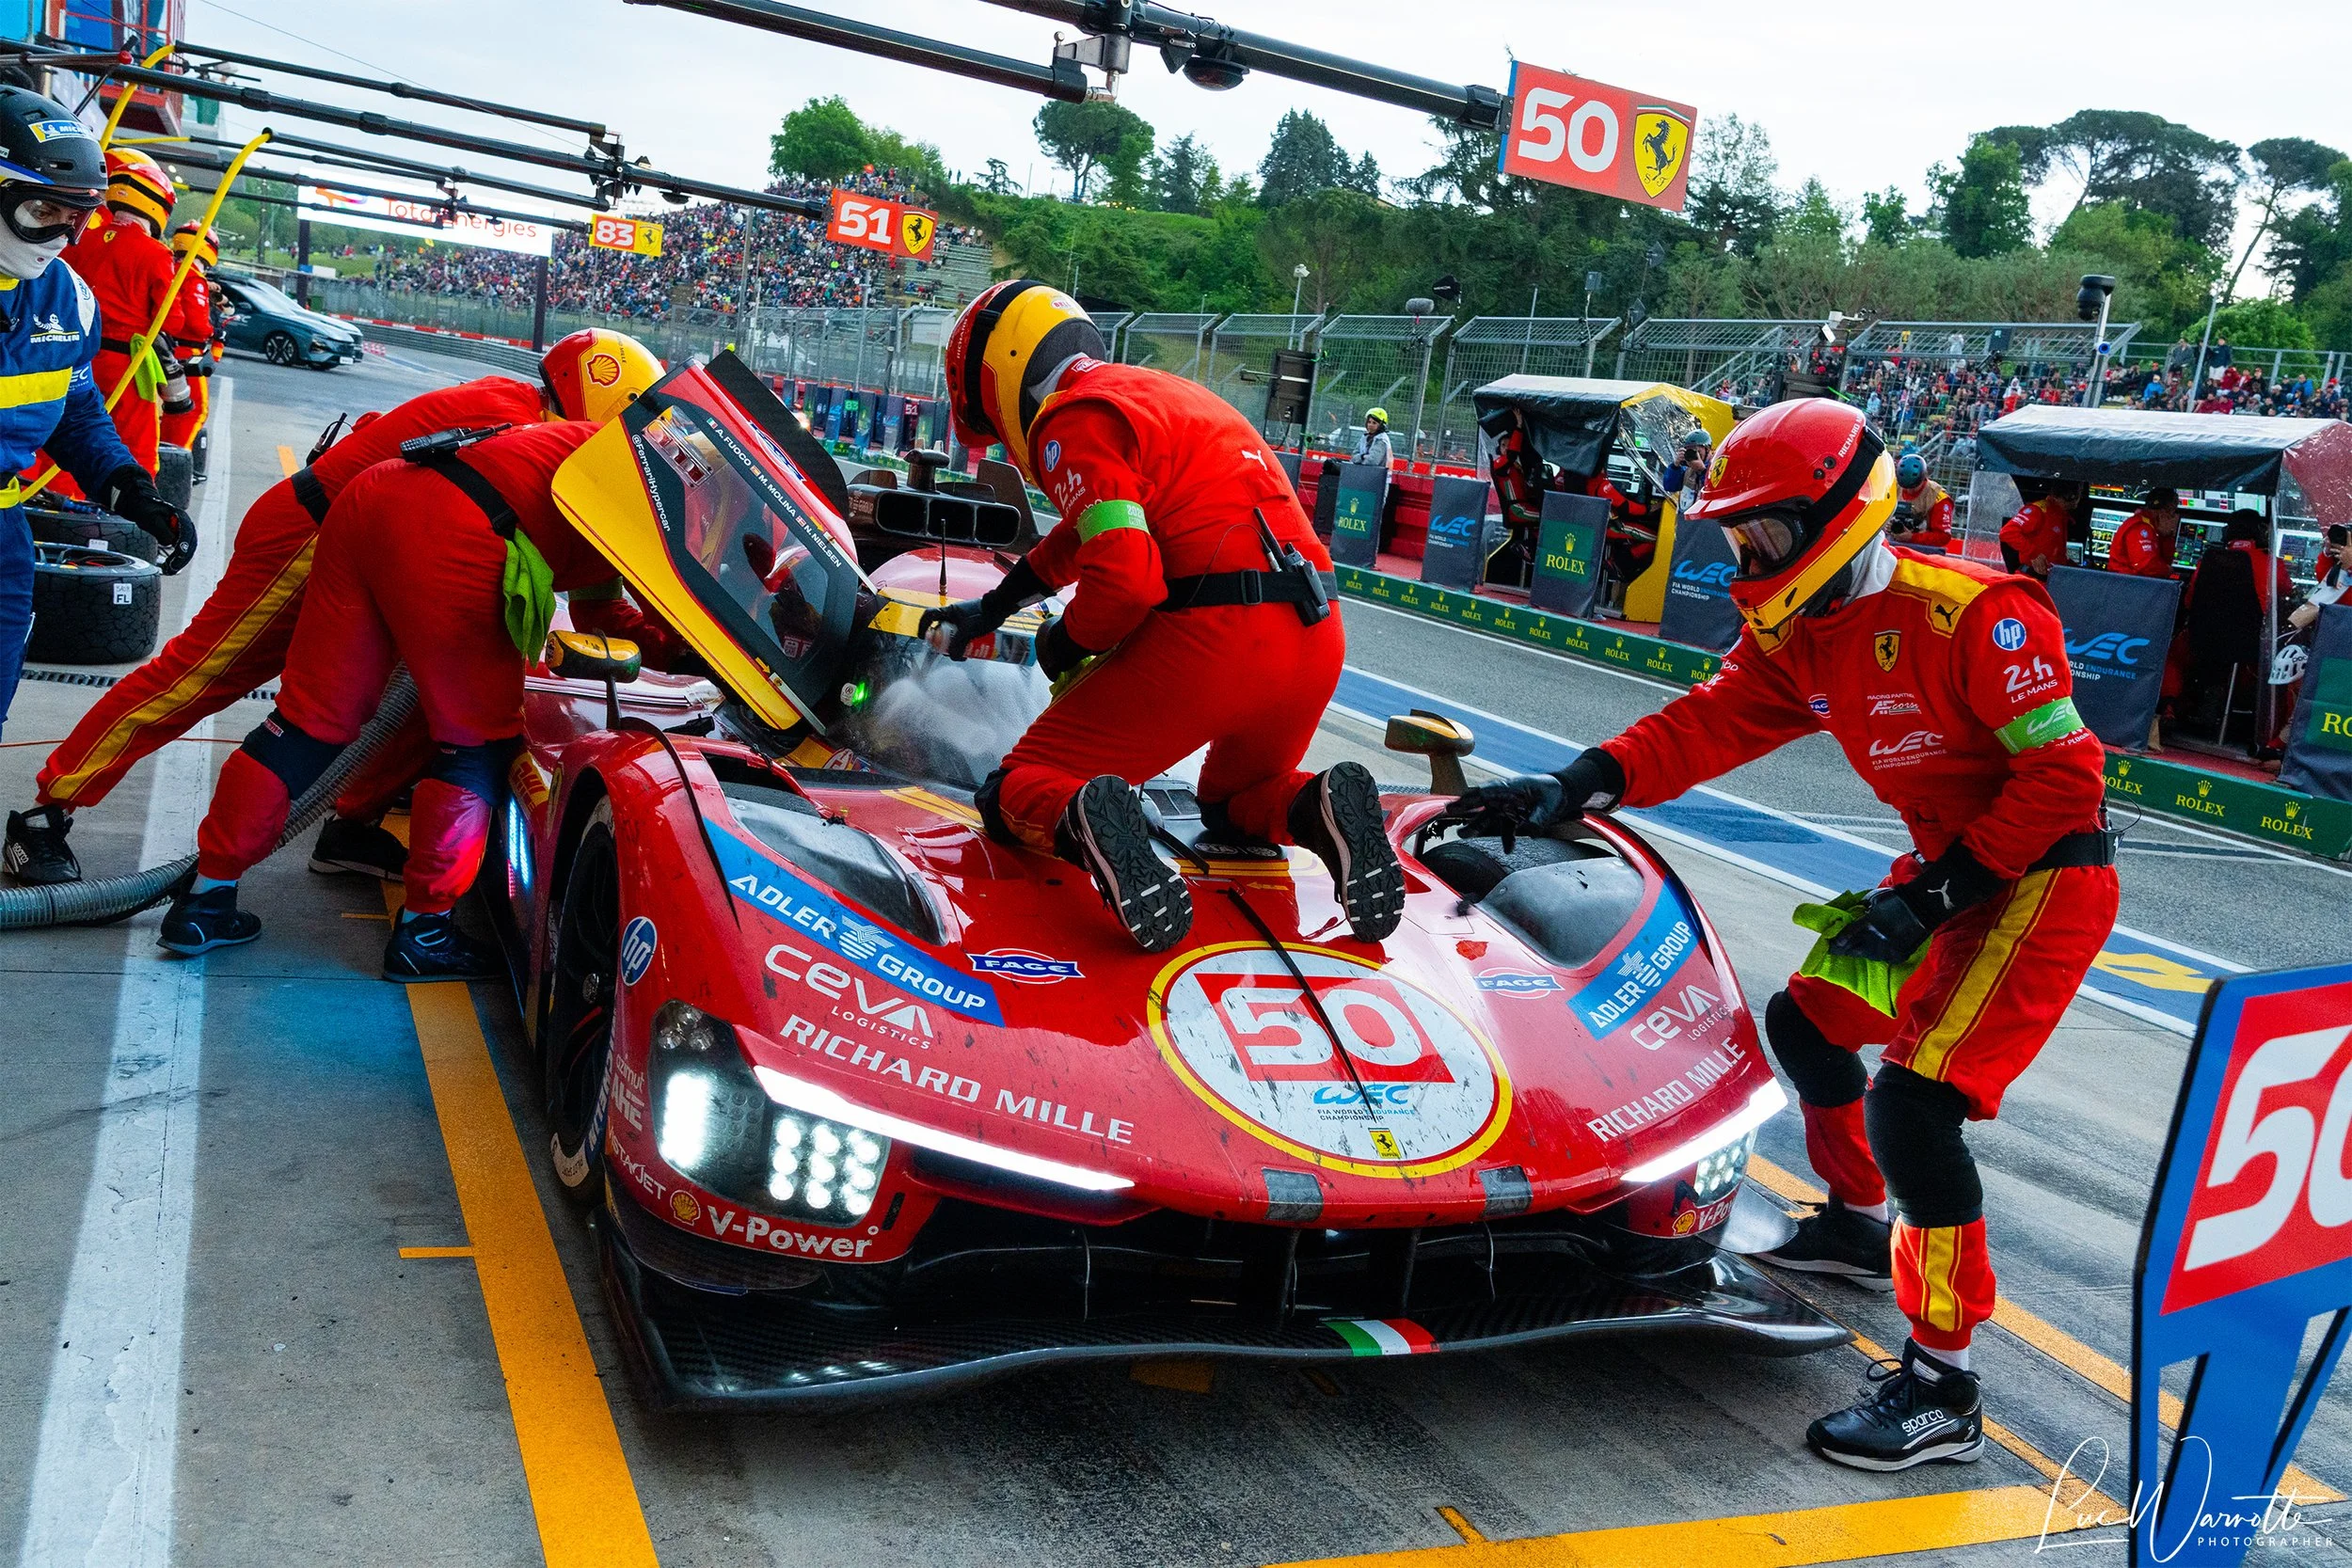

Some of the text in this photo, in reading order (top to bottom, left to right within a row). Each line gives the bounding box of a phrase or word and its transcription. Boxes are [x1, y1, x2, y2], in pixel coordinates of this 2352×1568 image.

[1517, 87, 1619, 173] 50
[384, 198, 536, 238] Totanergies
[837, 200, 893, 245] 51
[596, 220, 634, 246] 83
[30, 334, 80, 343] MICHELIN
[70, 366, 89, 382] EC
[905, 404, 918, 415] 51
[1838, 423, 1860, 458] RICHARD
[1045, 443, 1057, 470] hp
[631, 434, 671, 532] @FerrariHypercar
[723, 436, 752, 467] FUOCO
[767, 483, 797, 518] MOLINA
[811, 531, 842, 568] NIELSEN
[1339, 516, 1366, 531] ROLEX
[1430, 515, 1476, 537] WEC
[1546, 554, 1585, 576] ROLEX
[1674, 560, 1739, 587] WEC
[117, 594, 130, 604] FL
[1671, 589, 1710, 601] CHAMPIONSHIP
[1681, 583, 1701, 593] WORLD
[1430, 601, 1450, 612] ROLEX
[1462, 610, 1482, 621] ROLEX
[1494, 617, 1516, 630] ROLEX
[1529, 626, 1550, 640] ROLEX
[1998, 620, 2022, 649] hp
[1565, 637, 1590, 651] ROLEX
[1605, 647, 1630, 661] ROLEX
[2062, 628, 2151, 665] WEC
[1646, 658, 1674, 673] ROLEX
[1691, 670, 1714, 682] ROLE
[2069, 660, 2137, 680] RLD ENDURANCE
[2070, 669, 2101, 681] ONSHIP
[2010, 679, 2058, 704] LE MANS
[1869, 730, 1944, 756] WEC
[1906, 749, 1947, 760] ENDURANCE
[1874, 759, 1921, 770] CHAMPIONSHIP
[2175, 794, 2226, 817] ROLEX
[2260, 816, 2314, 841] ROLEX
[728, 874, 986, 1009] ADLER GROUP
[1588, 920, 1692, 1029] ADLER GROUP
[831, 1006, 931, 1050] LOGISTICS
[1221, 986, 1422, 1066] 50
[1687, 1003, 1731, 1041] LOGISTICS
[779, 1014, 1136, 1144] RICHARD MILLE
[1586, 1037, 1746, 1143] RICHARD MILLE
[1312, 1084, 1410, 1105] WEC
[1698, 1199, 1734, 1230] V-Po
[707, 1205, 873, 1258] V-Power
[1901, 1409, 1945, 1435] sparco
